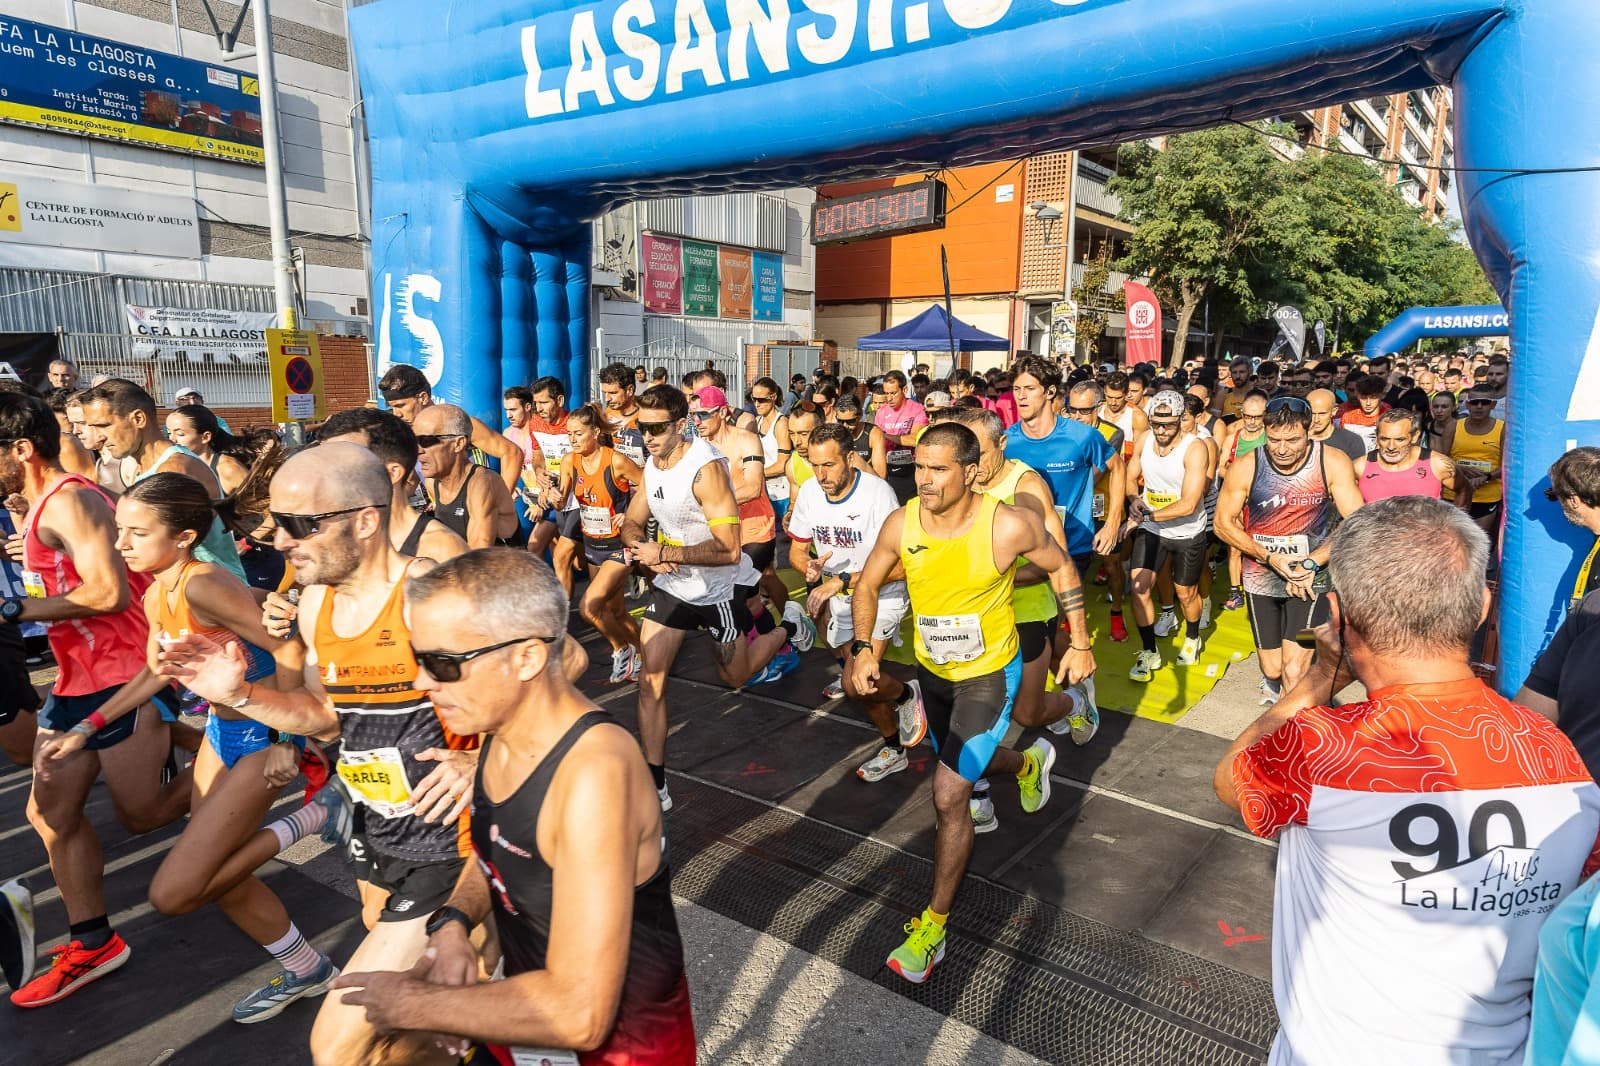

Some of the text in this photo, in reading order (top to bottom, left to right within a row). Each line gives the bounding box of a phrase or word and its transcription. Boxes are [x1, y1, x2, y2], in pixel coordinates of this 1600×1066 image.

[34, 29, 59, 48] LA
[69, 37, 157, 70] LLAGOSTA
[45, 48, 77, 67] les
[88, 60, 156, 84] classes
[52, 89, 137, 111] Institut Marina
[64, 101, 76, 110] C/
[97, 88, 129, 102] Tarda:
[26, 200, 193, 227] CENTRE DE FORMACIÓ D'ADULTS
[31, 212, 105, 228] LA LLAGOSTA
[181, 327, 199, 338] LA
[929, 633, 969, 642] JONATHAN
[1389, 800, 1527, 879] 90
[1480, 850, 1540, 891] Anys
[1401, 881, 1562, 917] La Llagosta
